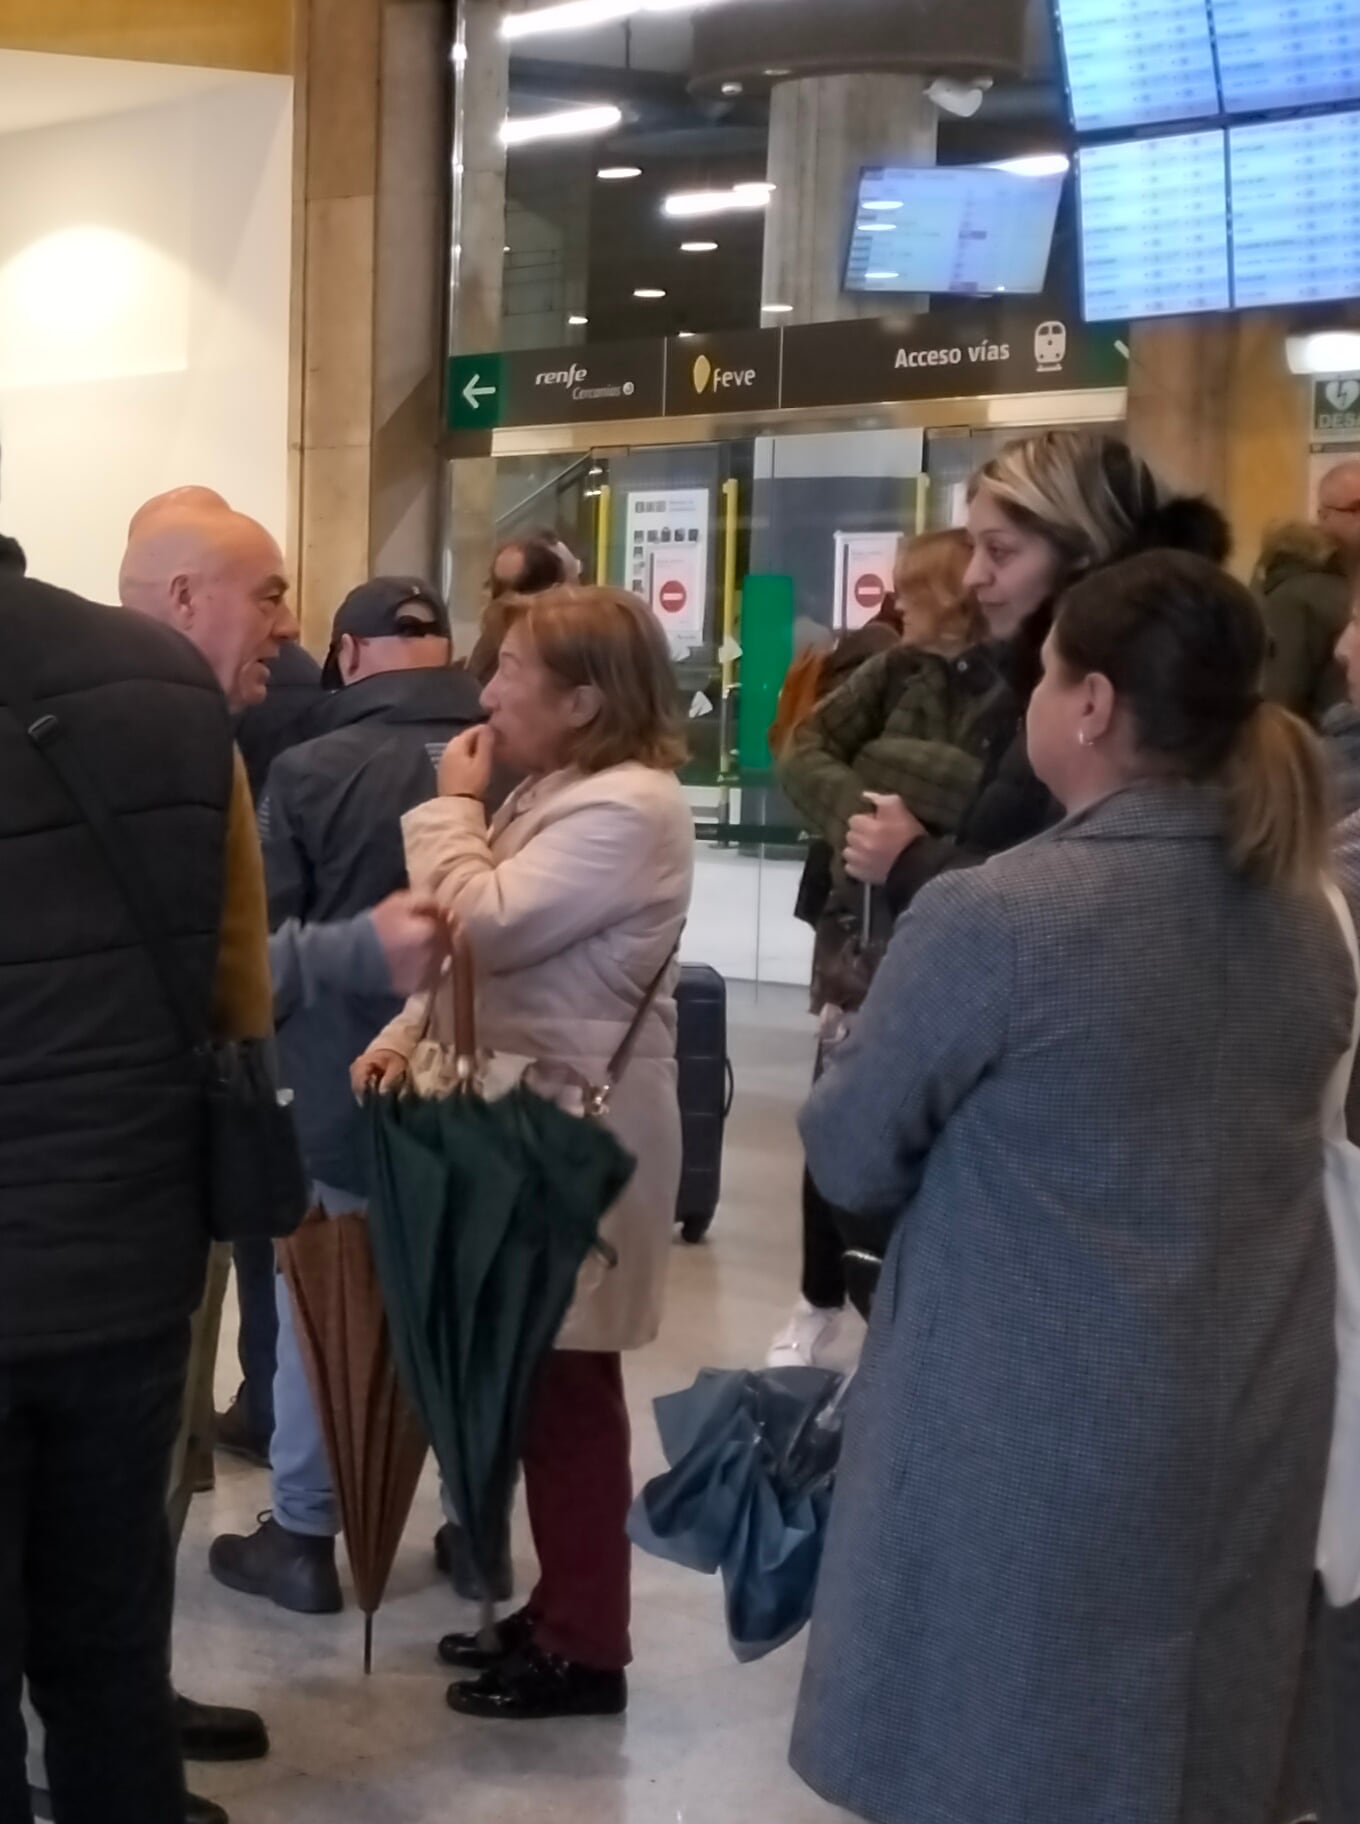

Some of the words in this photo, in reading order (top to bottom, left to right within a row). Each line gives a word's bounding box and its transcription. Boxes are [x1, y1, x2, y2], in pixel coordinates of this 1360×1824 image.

[894, 348, 962, 368] Acceso
[968, 339, 1010, 362] vías
[535, 363, 588, 388] renfe
[713, 366, 756, 392] feve
